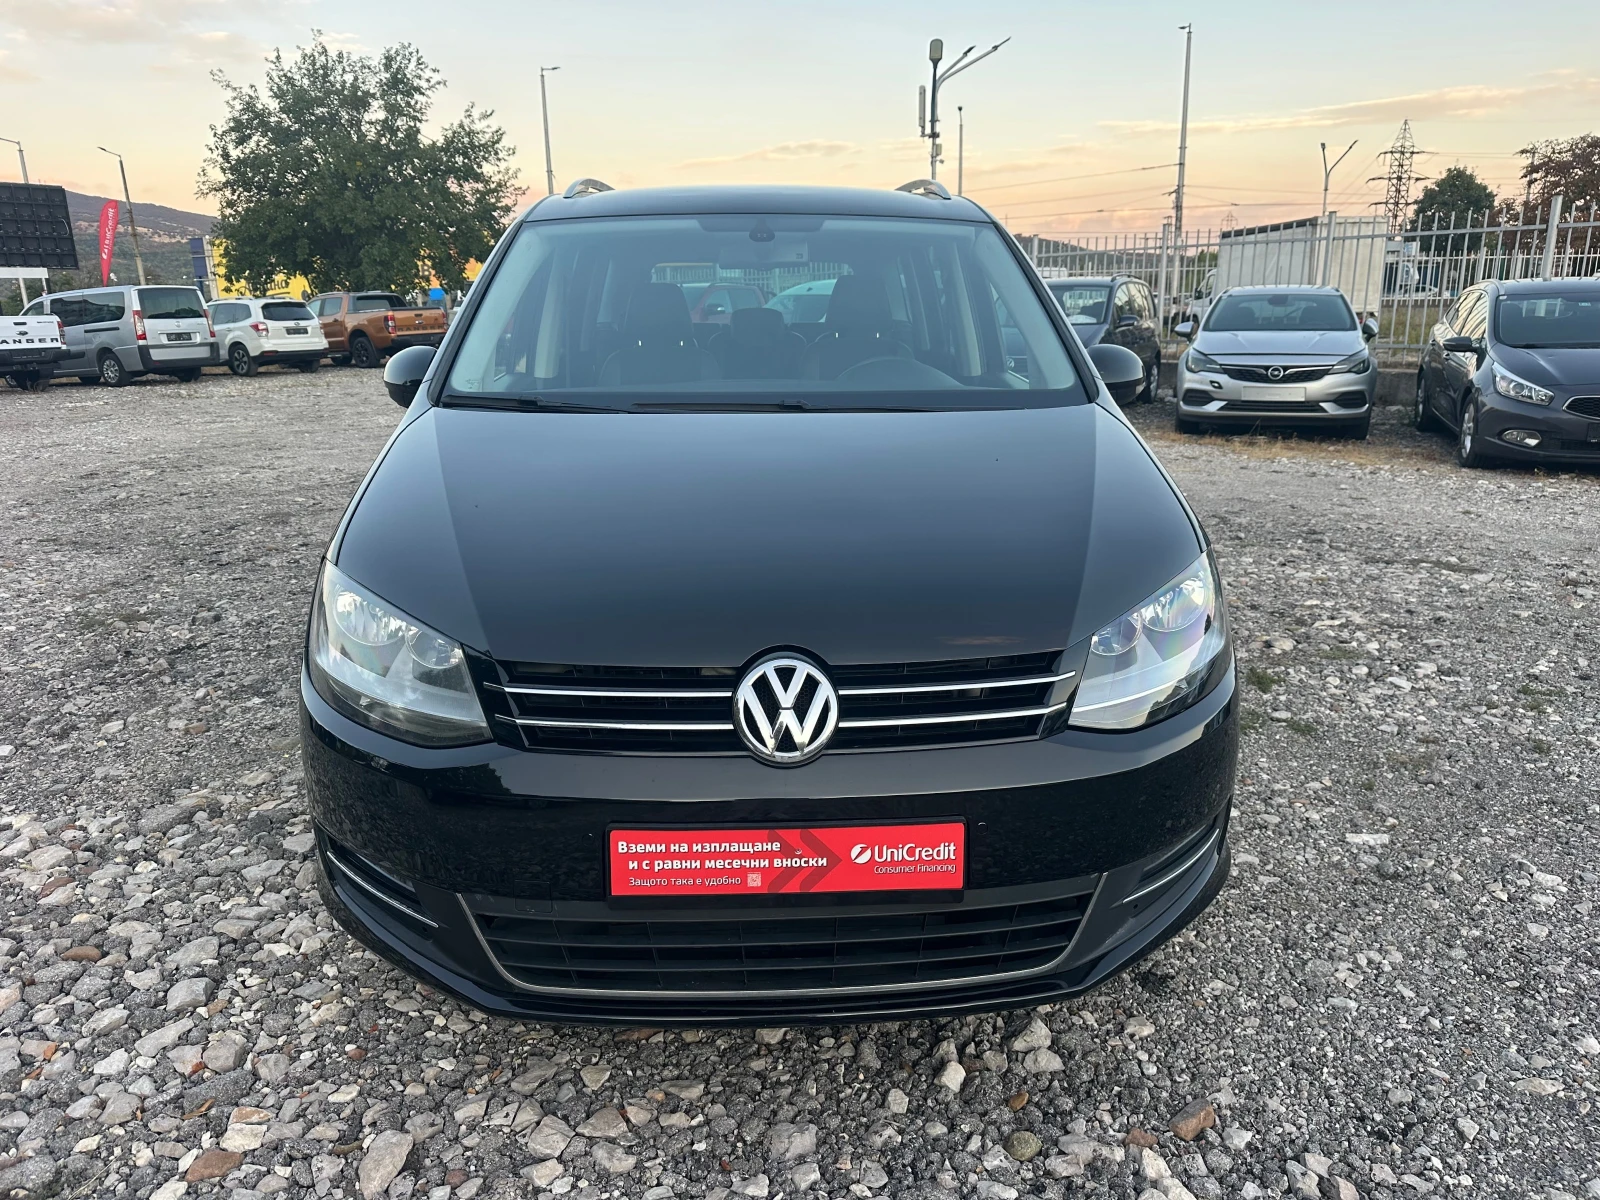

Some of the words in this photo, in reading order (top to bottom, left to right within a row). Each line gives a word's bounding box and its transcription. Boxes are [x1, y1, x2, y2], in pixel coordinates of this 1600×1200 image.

[0, 337, 59, 345] ANGER
[617, 841, 666, 853] Вземи
[670, 843, 688, 853] на
[692, 842, 781, 854] изплащане
[874, 842, 956, 862] UniCredit
[628, 860, 638, 870] и
[642, 860, 650, 870] с
[654, 859, 701, 873] равни
[705, 858, 769, 869] месечни
[773, 856, 828, 868] вноски
[874, 865, 916, 874] Consumer
[917, 863, 956, 874] Financing
[628, 877, 668, 887] Защото
[670, 878, 694, 886] така
[704, 876, 741, 887] удобно
